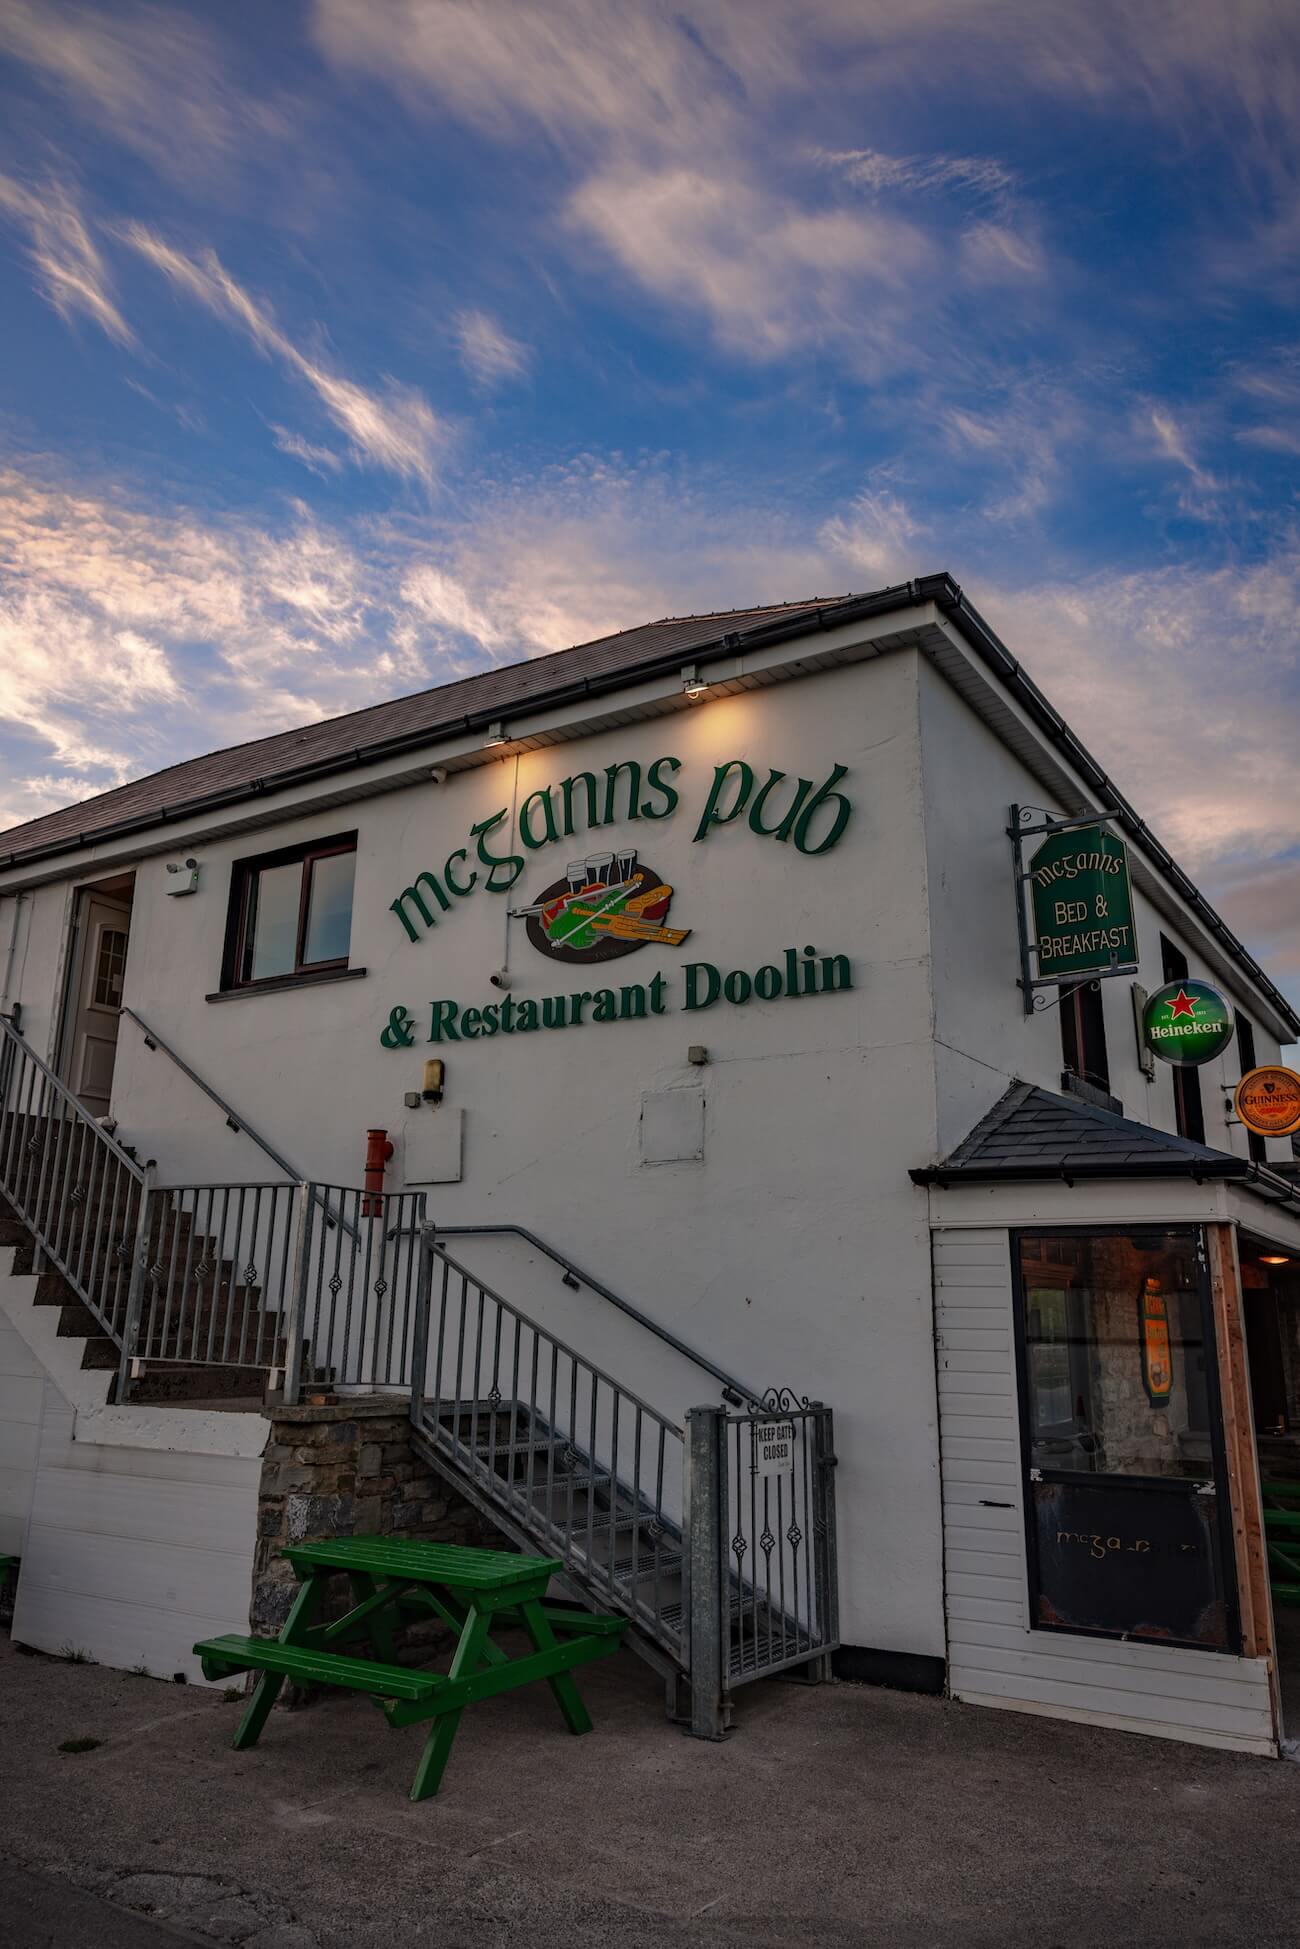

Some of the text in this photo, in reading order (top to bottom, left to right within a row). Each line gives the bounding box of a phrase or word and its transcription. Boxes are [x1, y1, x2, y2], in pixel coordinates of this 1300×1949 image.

[1095, 894, 1109, 918] &
[380, 945, 854, 1049] & Restaurant Doolin
[1150, 1021, 1223, 1040] Heineken
[1244, 1094, 1298, 1105] GUINNESS
[758, 1425, 792, 1442] KEEP GATE
[763, 1443, 788, 1460] CLOSED
